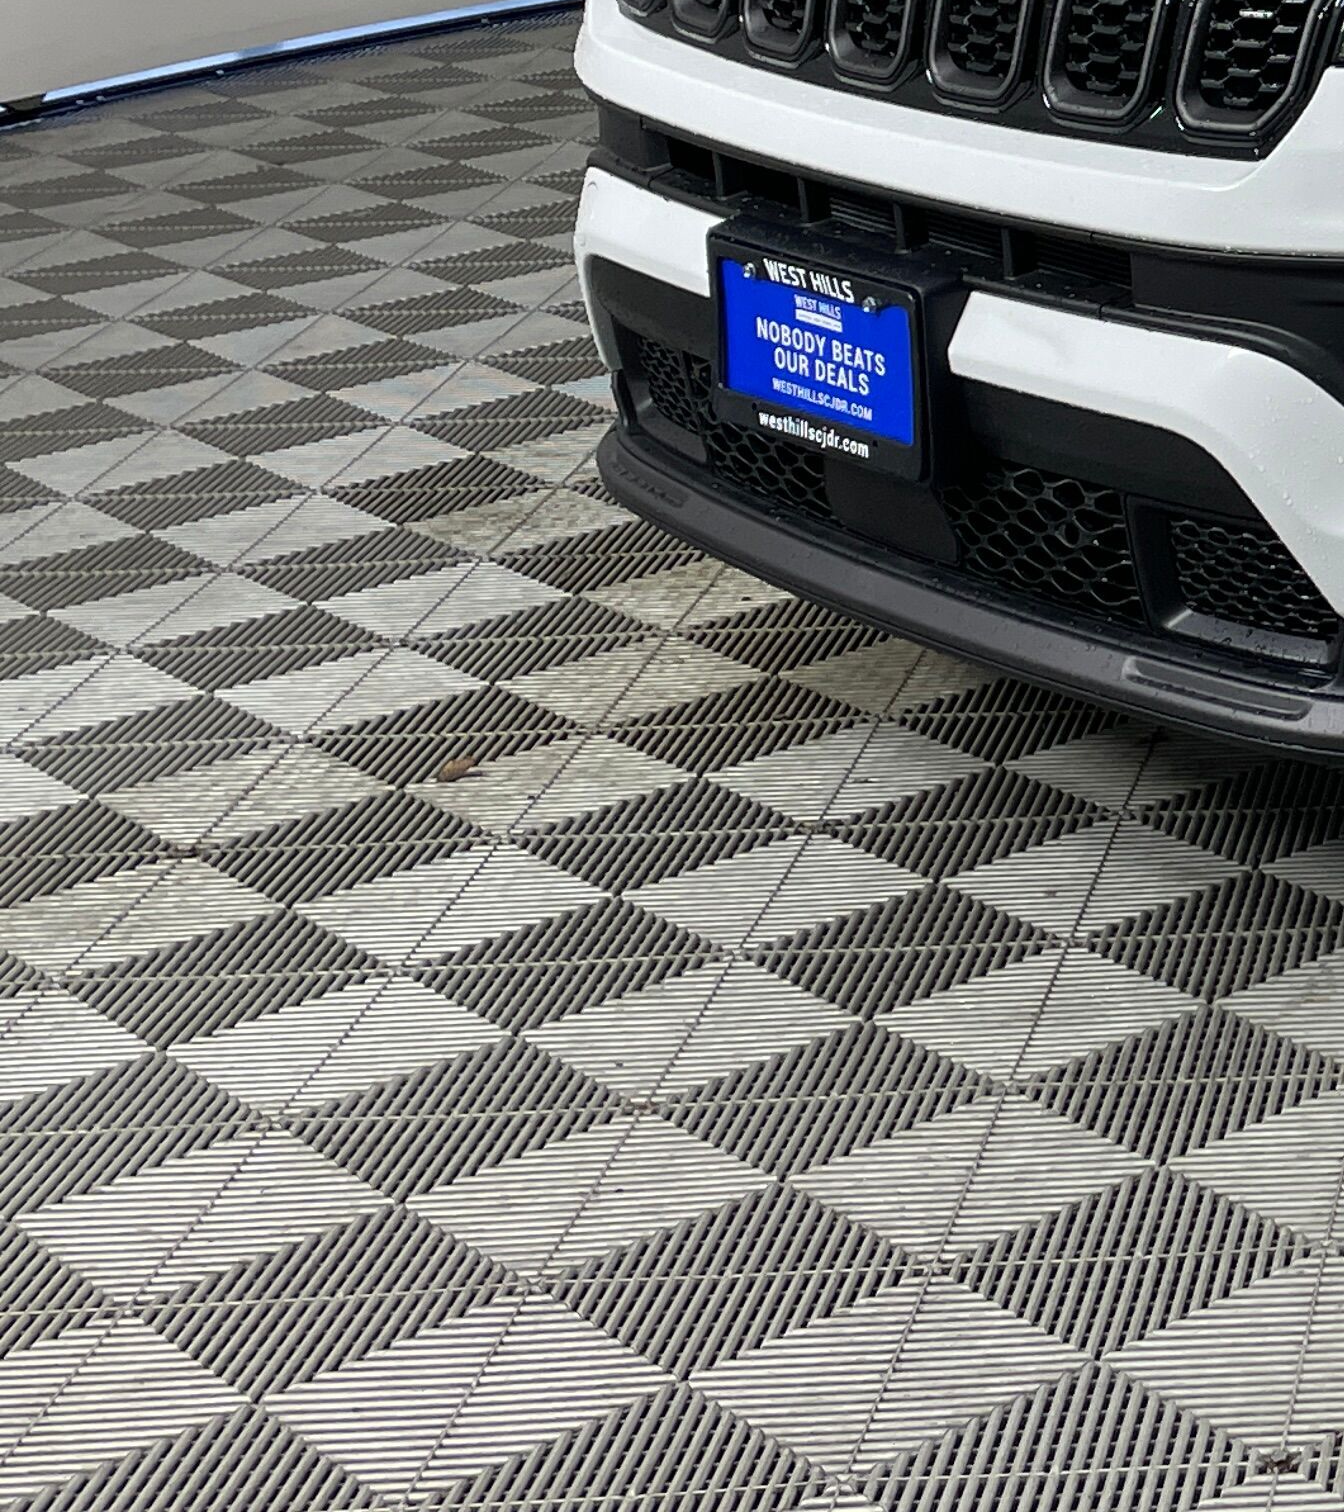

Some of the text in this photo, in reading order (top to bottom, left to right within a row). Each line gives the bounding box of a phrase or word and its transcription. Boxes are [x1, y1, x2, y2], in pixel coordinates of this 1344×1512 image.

[764, 258, 854, 303] WEST HILLS
[794, 294, 841, 319] WEST HILLS
[756, 317, 826, 357] NOBODY
[832, 341, 885, 376] BEATS
[774, 347, 869, 395] OUR DEALS
[772, 378, 872, 420] WESTHILLSCJDR.COM
[758, 412, 869, 459] westhillscjdr.com
